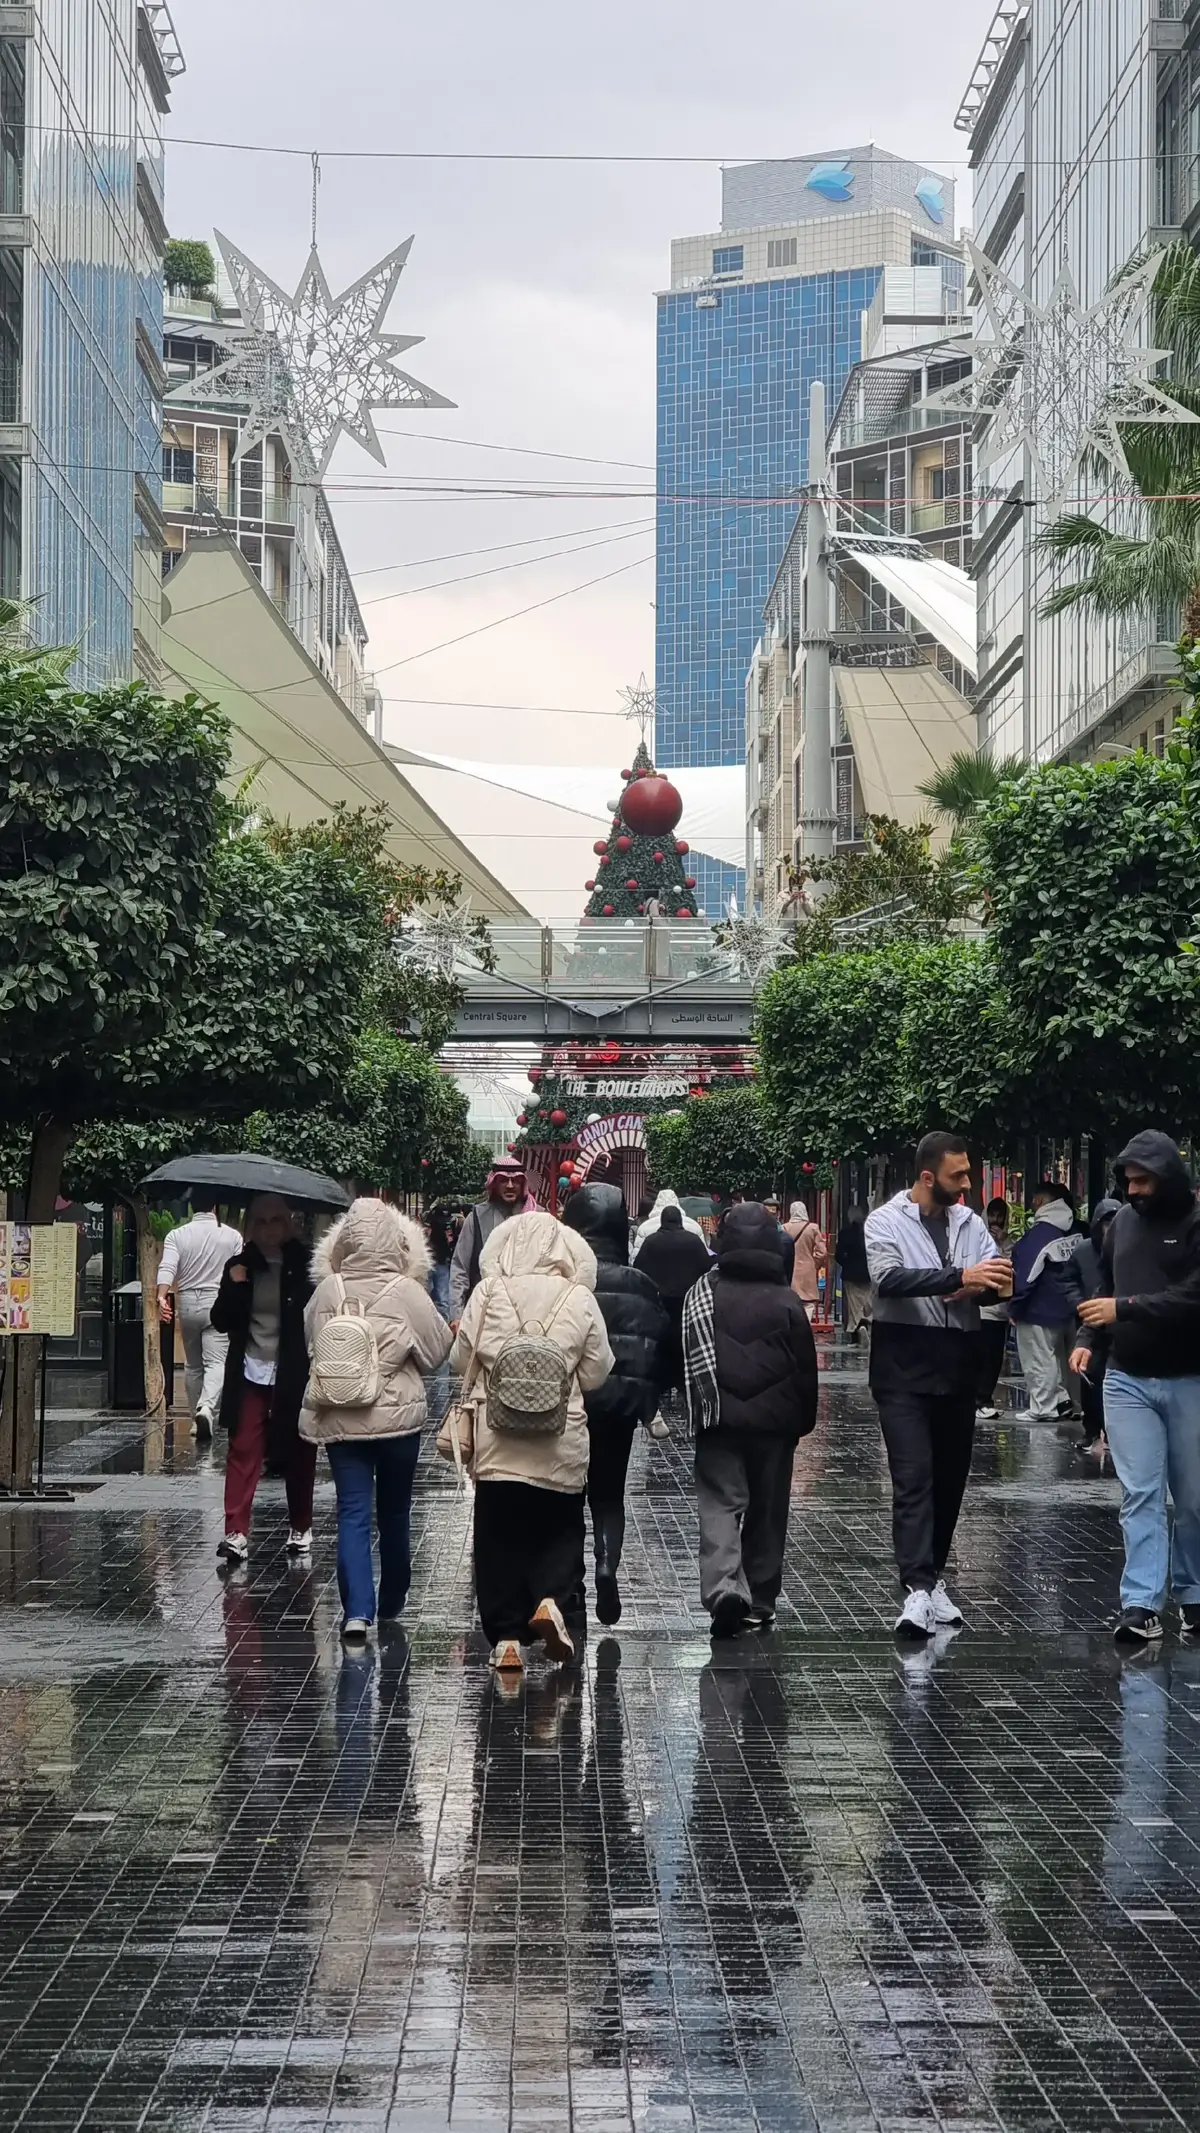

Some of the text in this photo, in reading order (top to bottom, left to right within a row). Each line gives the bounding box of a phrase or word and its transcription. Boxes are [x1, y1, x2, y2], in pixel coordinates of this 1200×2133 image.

[463, 1012, 527, 1022] Central Square
[671, 1013, 733, 1023] الساحة الوسطى
[567, 1080, 588, 1096] THE
[576, 1117, 616, 1149] CANDY
